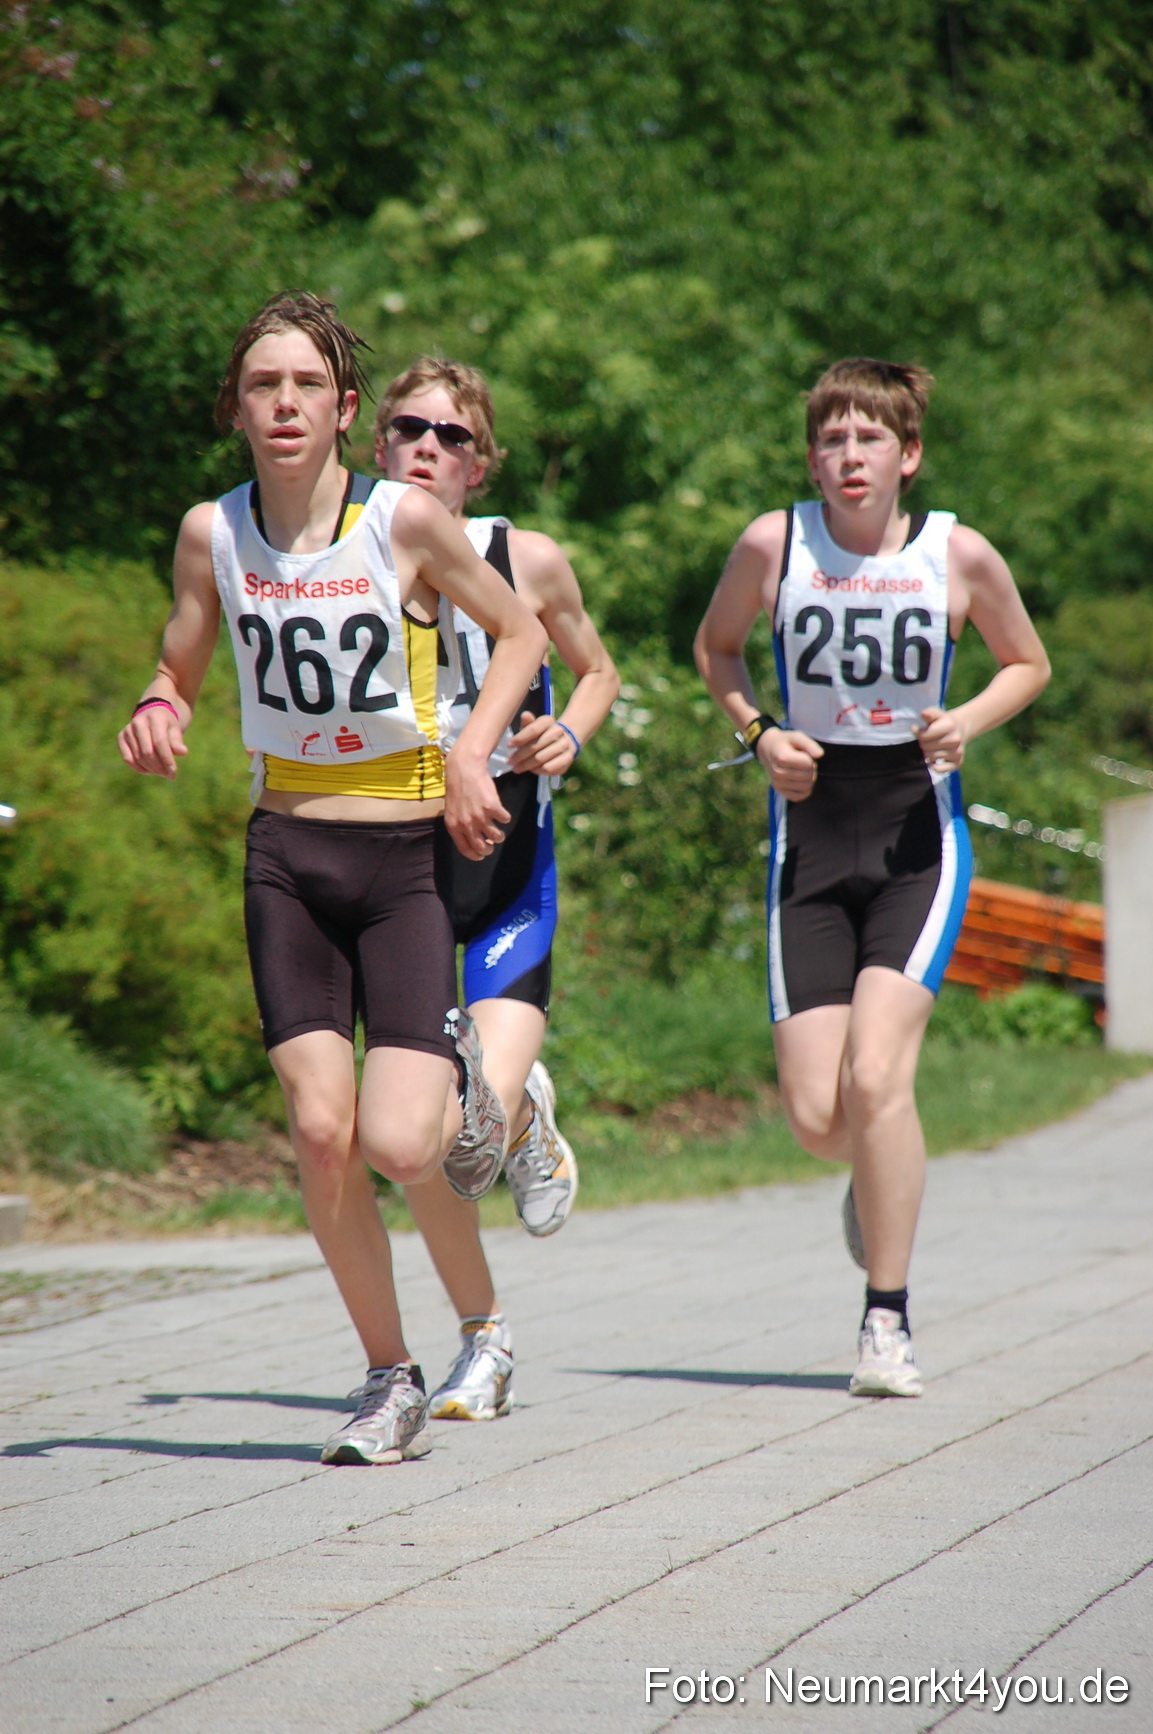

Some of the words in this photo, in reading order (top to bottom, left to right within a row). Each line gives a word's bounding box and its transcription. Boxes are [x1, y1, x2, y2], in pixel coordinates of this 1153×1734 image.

[244, 572, 370, 601] Sparkasse
[811, 570, 923, 594] Sparkasse
[237, 613, 398, 715] 262
[794, 605, 932, 688] 256
